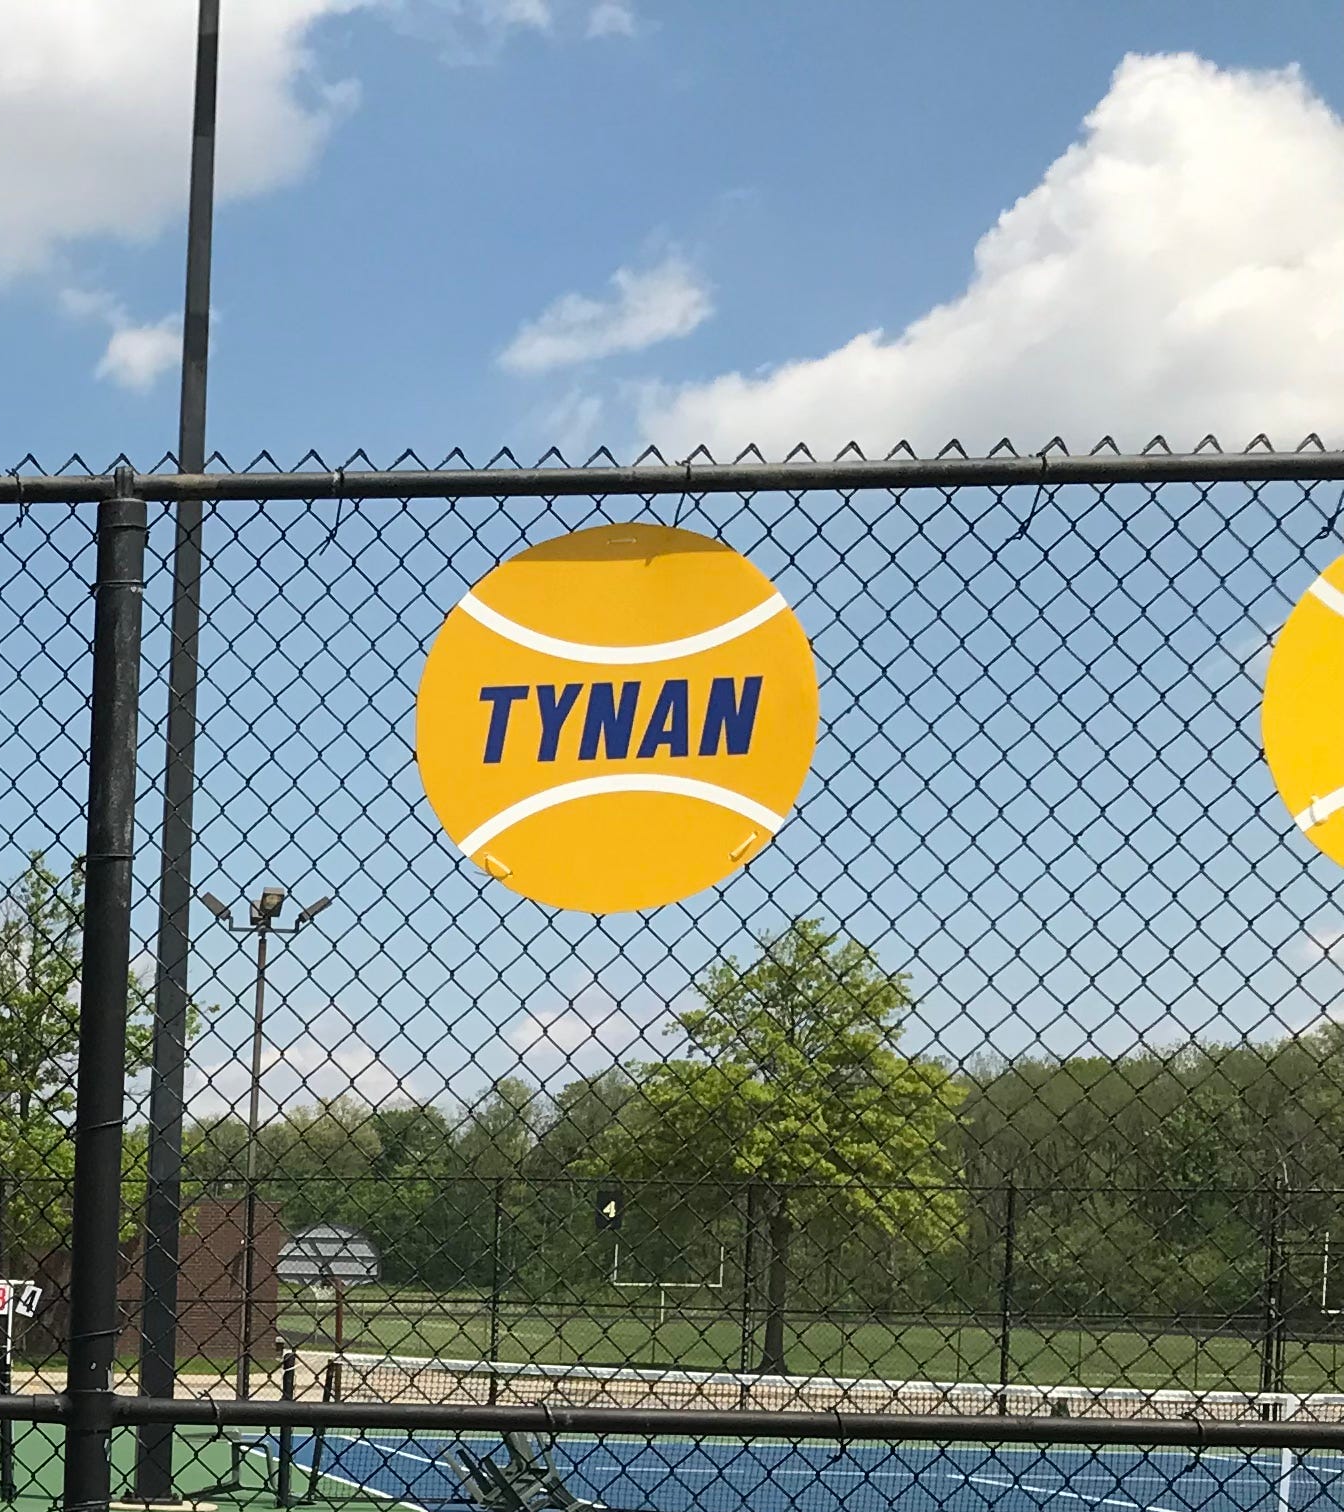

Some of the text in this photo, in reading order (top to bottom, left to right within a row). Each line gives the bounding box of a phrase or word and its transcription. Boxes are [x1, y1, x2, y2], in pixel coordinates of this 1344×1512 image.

[479, 676, 763, 764] TYNAN
[602, 1200, 616, 1218] 4
[23, 1289, 38, 1313] 4
